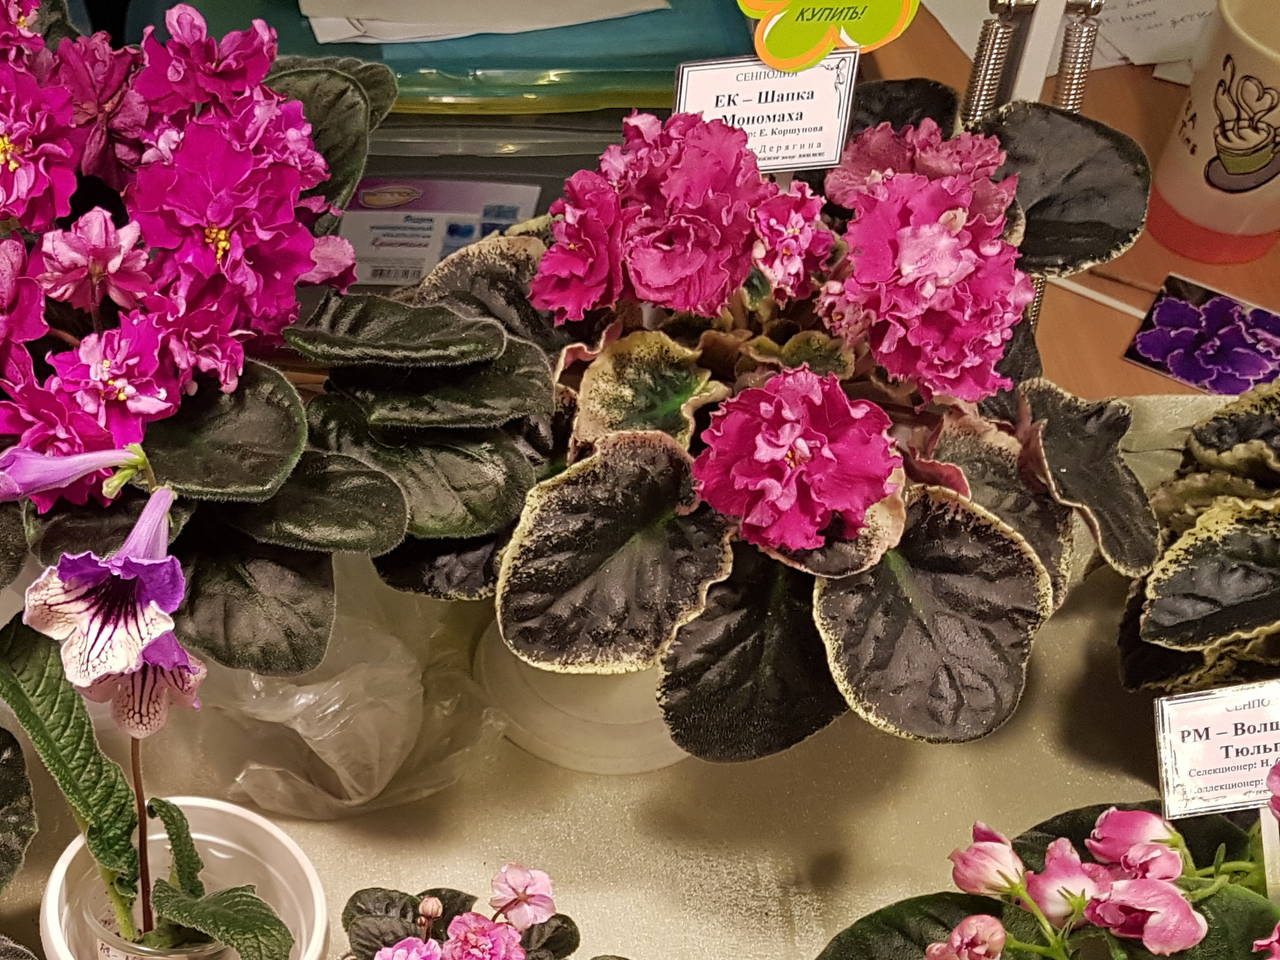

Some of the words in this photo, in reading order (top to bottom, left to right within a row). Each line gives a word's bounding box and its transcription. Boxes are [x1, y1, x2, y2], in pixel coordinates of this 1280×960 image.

[796, 5, 869, 22] КУПИТЬ!
[715, 93, 739, 108] ЕК
[758, 90, 815, 104] Шапка
[722, 111, 803, 127] Мономаха
[771, 126, 823, 137] Коршунова
[1180, 726, 1211, 743] РМ
[1188, 762, 1257, 778] Селекционер:
[1194, 778, 1264, 794] оллекционер:
